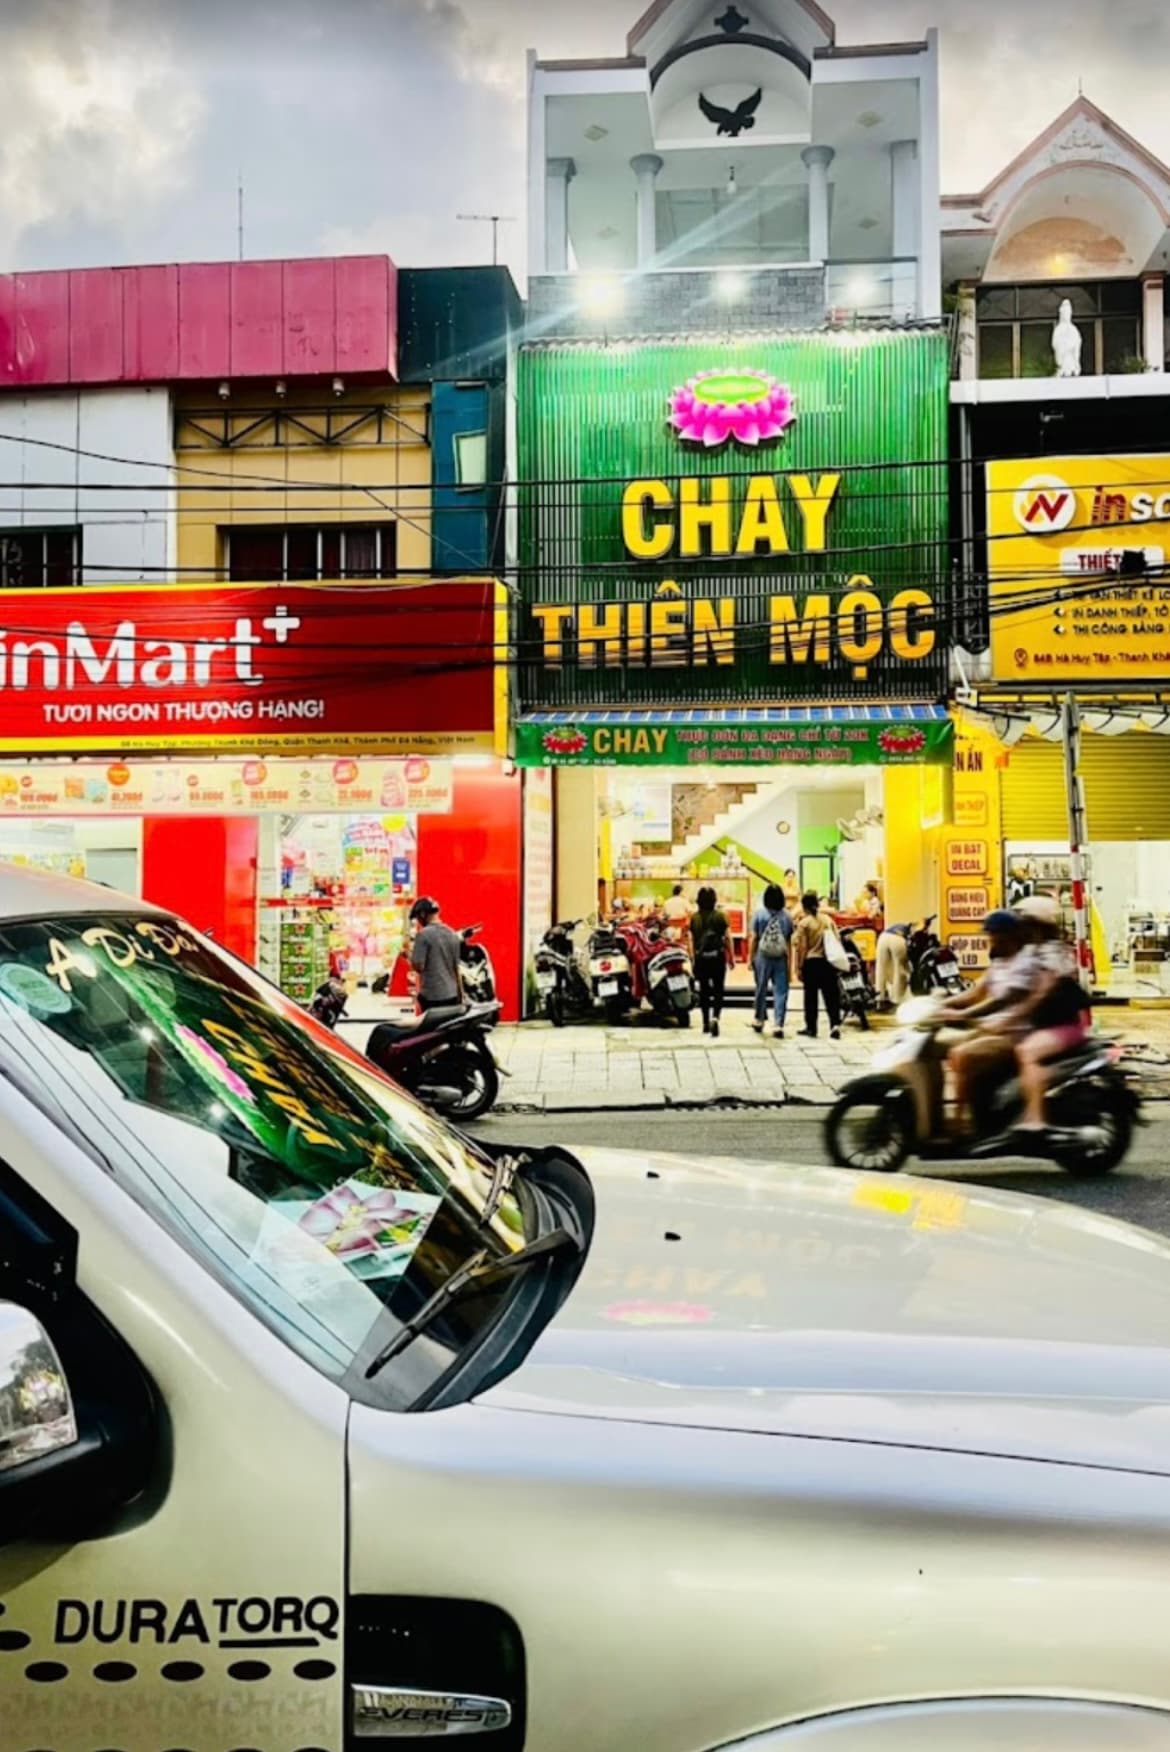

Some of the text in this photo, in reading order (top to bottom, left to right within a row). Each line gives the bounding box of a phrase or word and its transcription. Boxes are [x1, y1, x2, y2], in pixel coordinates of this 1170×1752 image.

[621, 473, 842, 559] CHAY
[532, 573, 936, 680] THIÊN MỘC
[1087, 608, 1117, 617] DANH
[1091, 622, 1127, 634] CÔNG
[97, 703, 158, 721] NGON
[165, 701, 252, 724] THƯỢNG
[257, 699, 326, 722] HẠNG!
[593, 727, 668, 754] CHAY
[46, 938, 97, 992] A
[54, 1595, 340, 1644] DURATORQ
